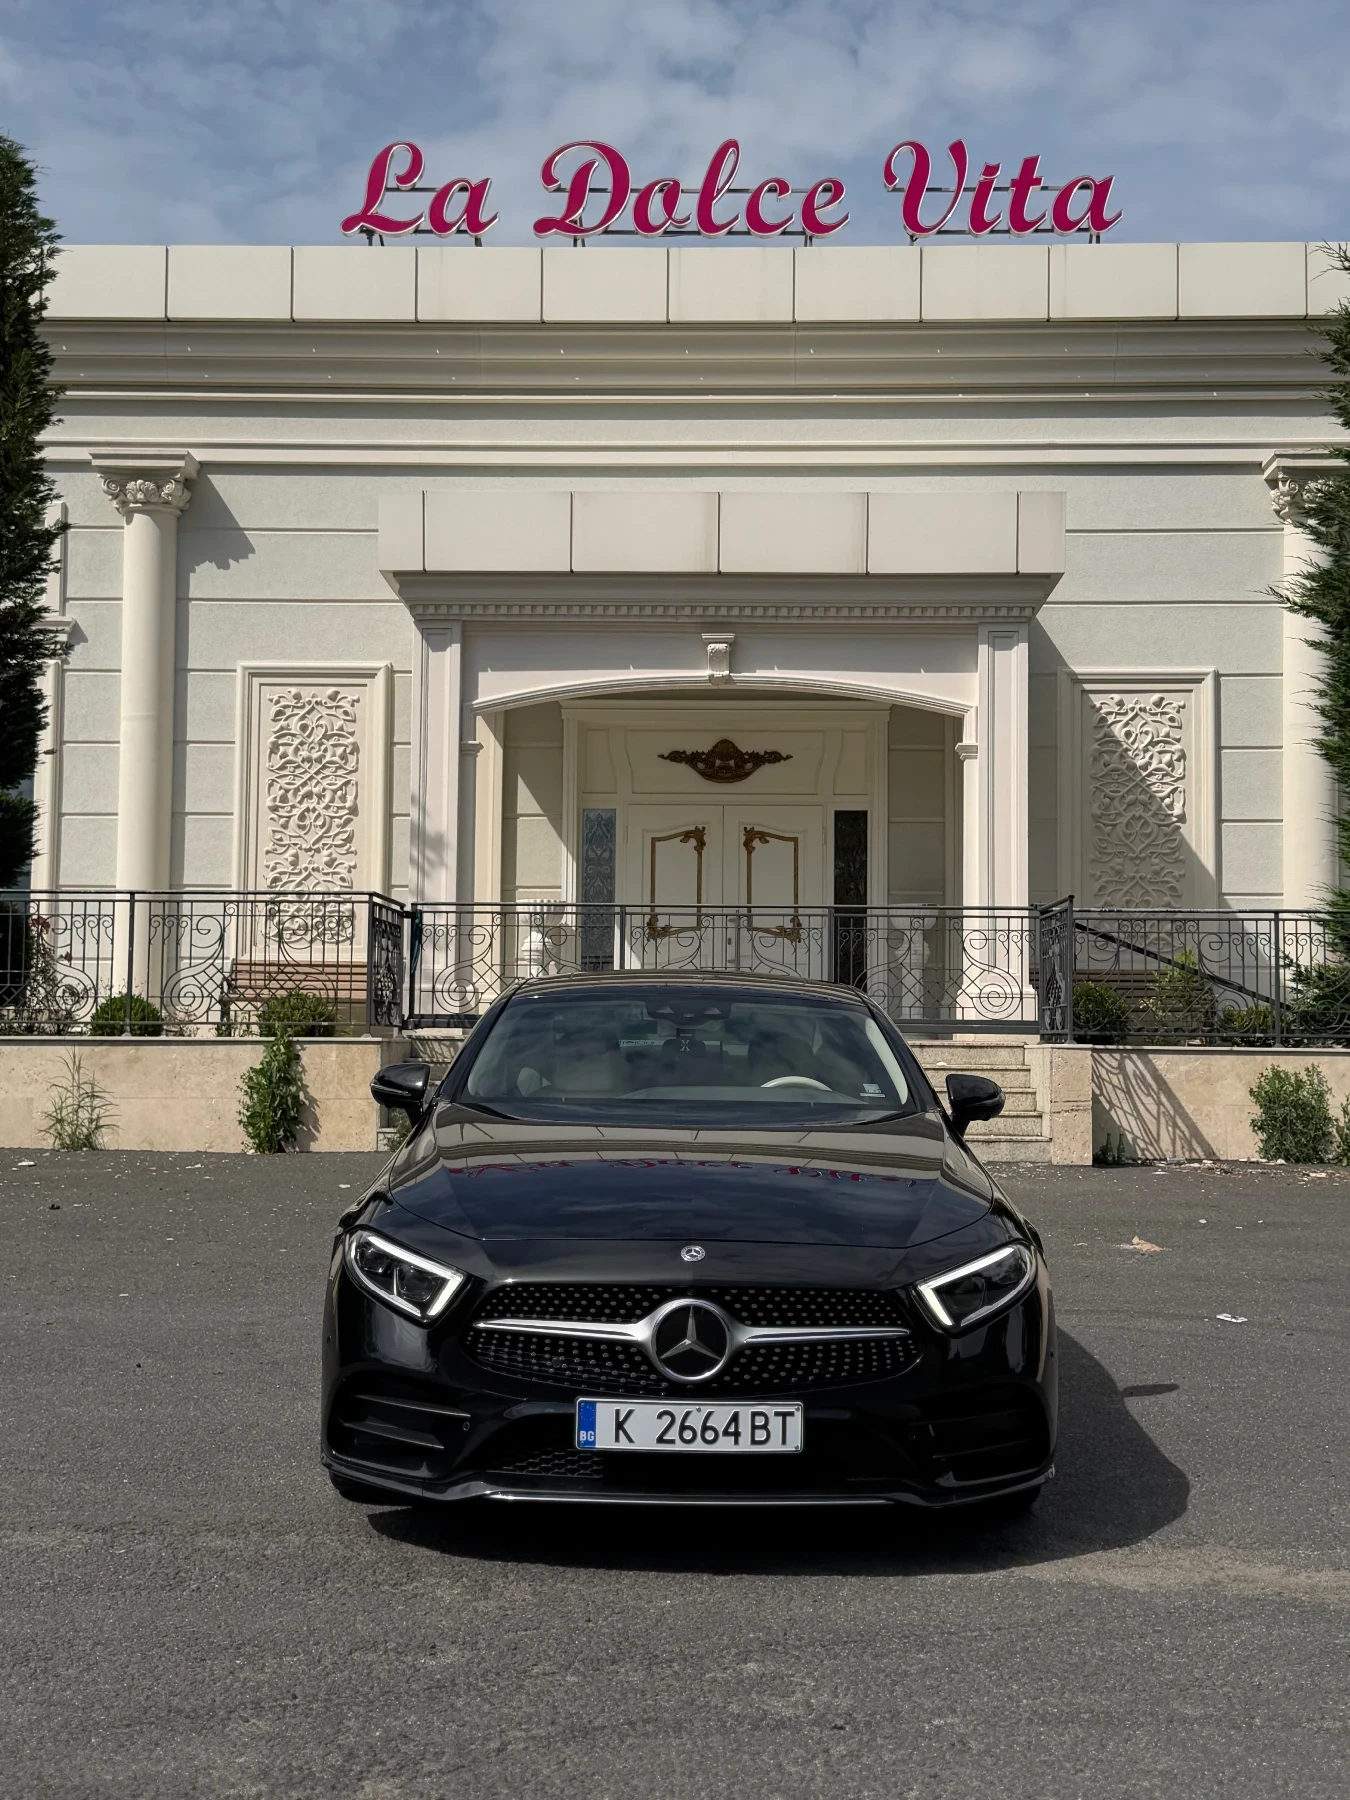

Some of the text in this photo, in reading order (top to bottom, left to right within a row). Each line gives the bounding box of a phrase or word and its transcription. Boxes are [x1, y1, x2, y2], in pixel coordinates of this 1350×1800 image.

[341, 139, 1124, 239] La Dolce Vita
[579, 1430, 595, 1442] BG
[614, 1408, 636, 1444] K
